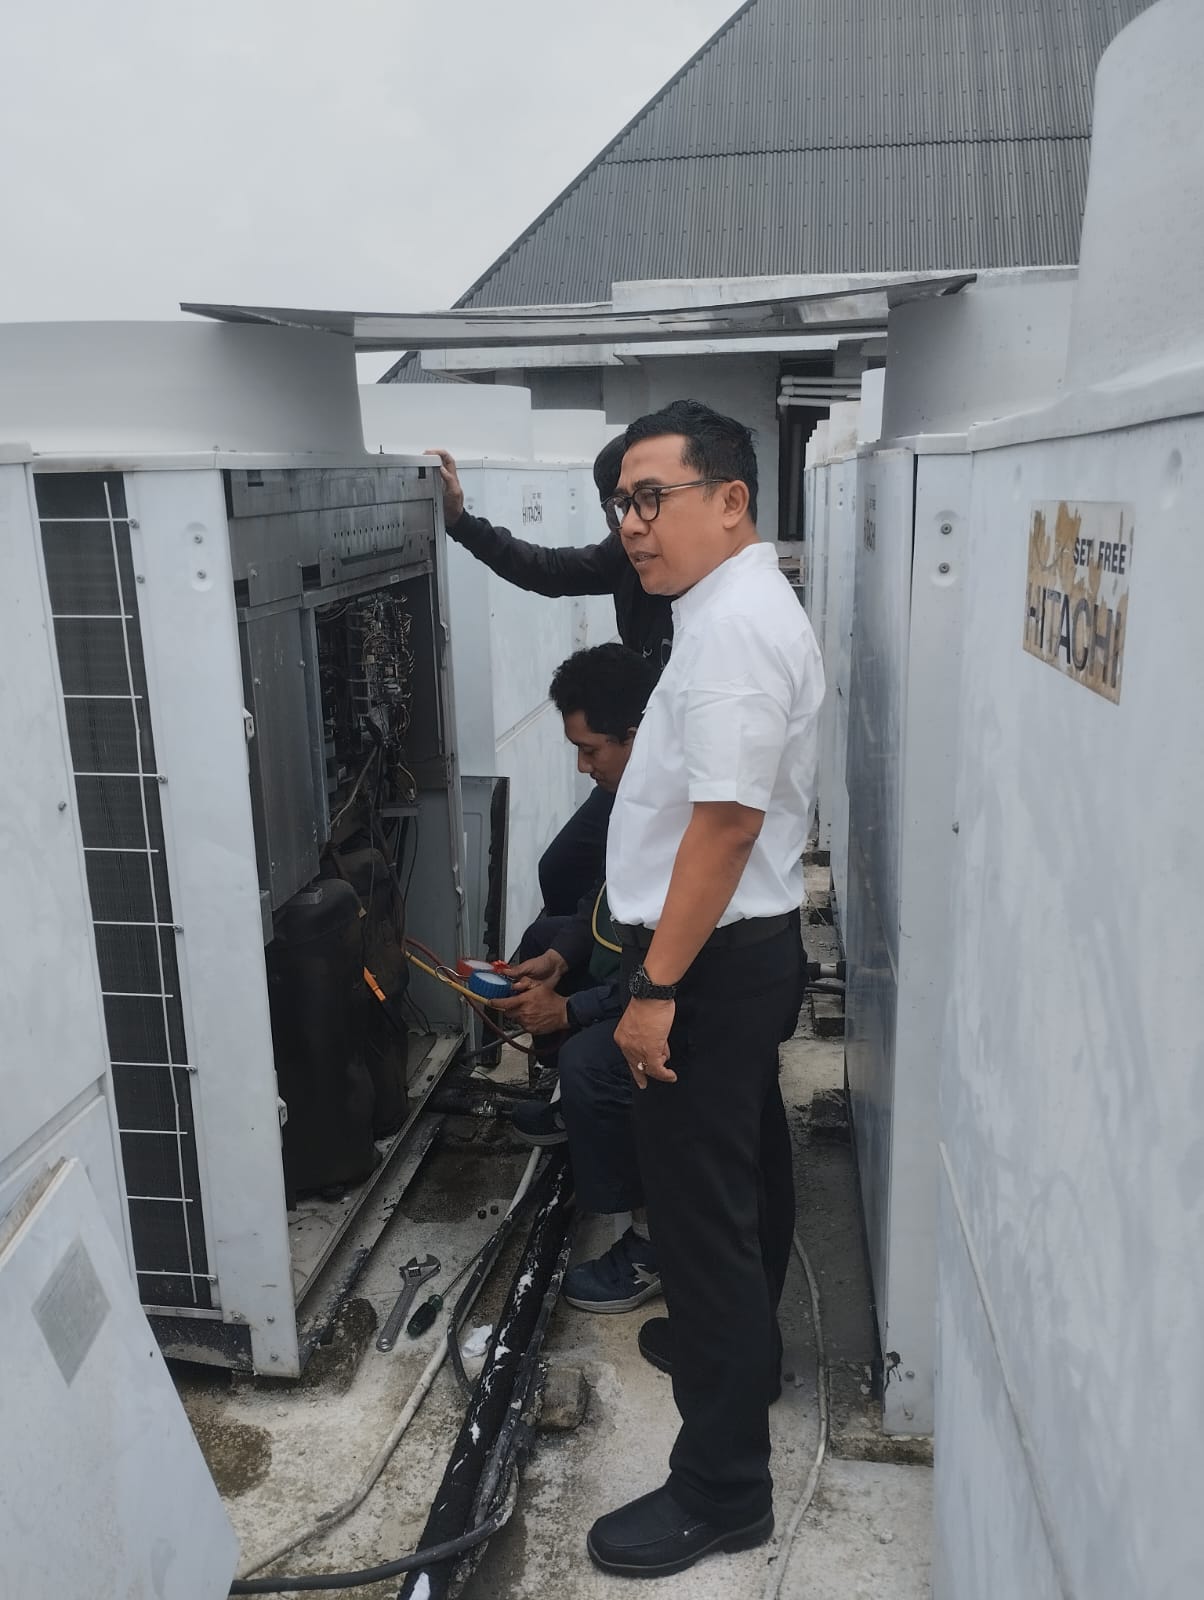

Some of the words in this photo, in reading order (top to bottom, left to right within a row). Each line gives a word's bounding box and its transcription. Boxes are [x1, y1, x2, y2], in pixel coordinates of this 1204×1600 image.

[1073, 537, 1093, 567] SET
[1097, 540, 1127, 575] FREE
[1025, 582, 1122, 689] HITACHI
